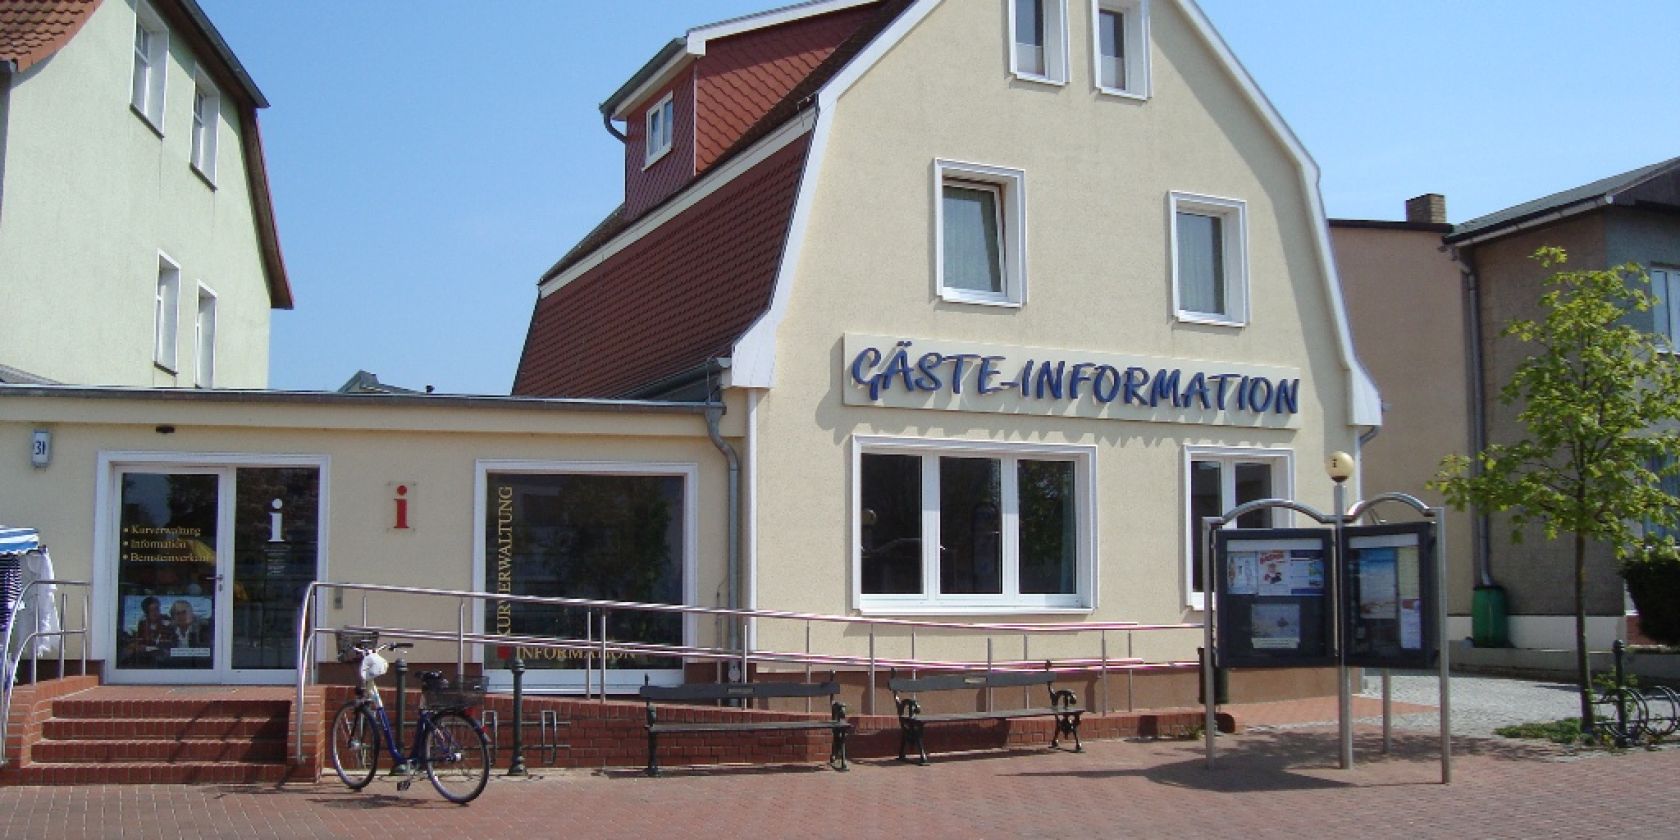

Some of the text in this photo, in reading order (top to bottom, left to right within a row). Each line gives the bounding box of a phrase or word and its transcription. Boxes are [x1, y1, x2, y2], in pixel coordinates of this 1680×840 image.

[852, 341, 1299, 413] GÄSTE-INFORMATION
[35, 440, 46, 455] 31
[268, 498, 285, 542] i
[394, 485, 410, 528] i
[130, 538, 186, 549] Information
[131, 525, 201, 537] Kurverwaltung
[497, 486, 513, 637] KURERWALTUNG
